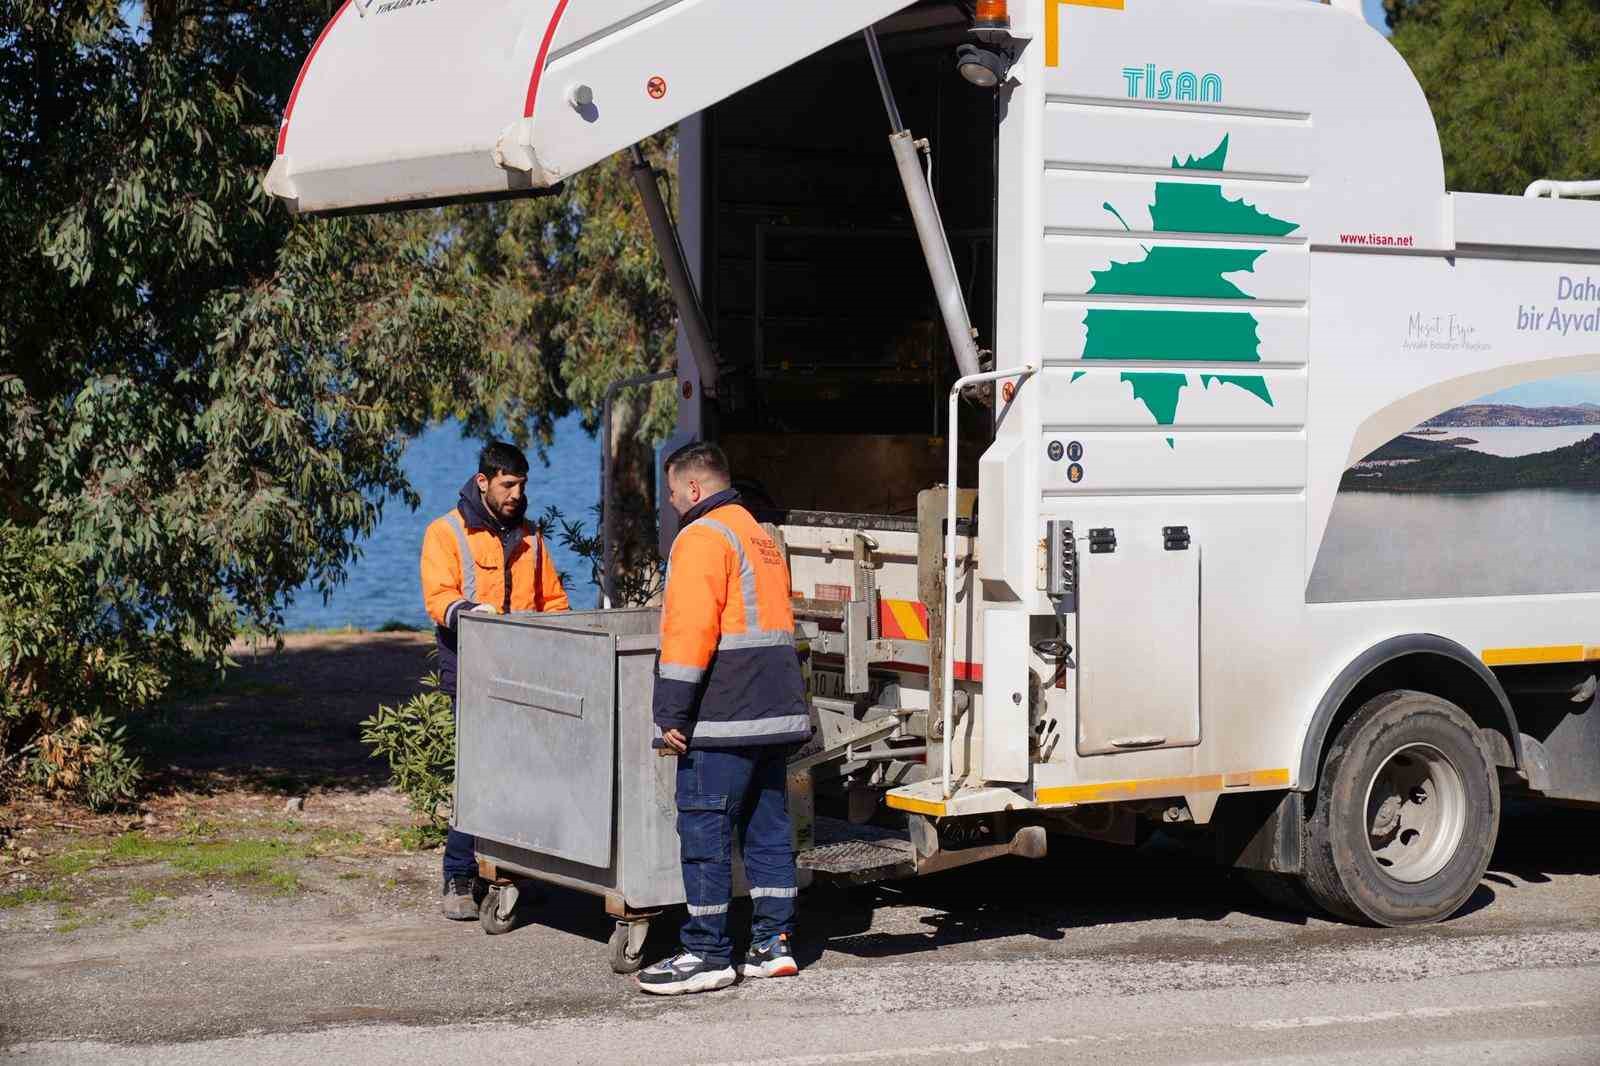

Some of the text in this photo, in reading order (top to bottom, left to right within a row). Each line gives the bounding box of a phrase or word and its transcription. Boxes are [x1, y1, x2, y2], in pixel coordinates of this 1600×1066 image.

[1340, 233, 1414, 247] www.tisan.net
[1557, 275, 1600, 301] Dah
[1516, 304, 1544, 330] bir
